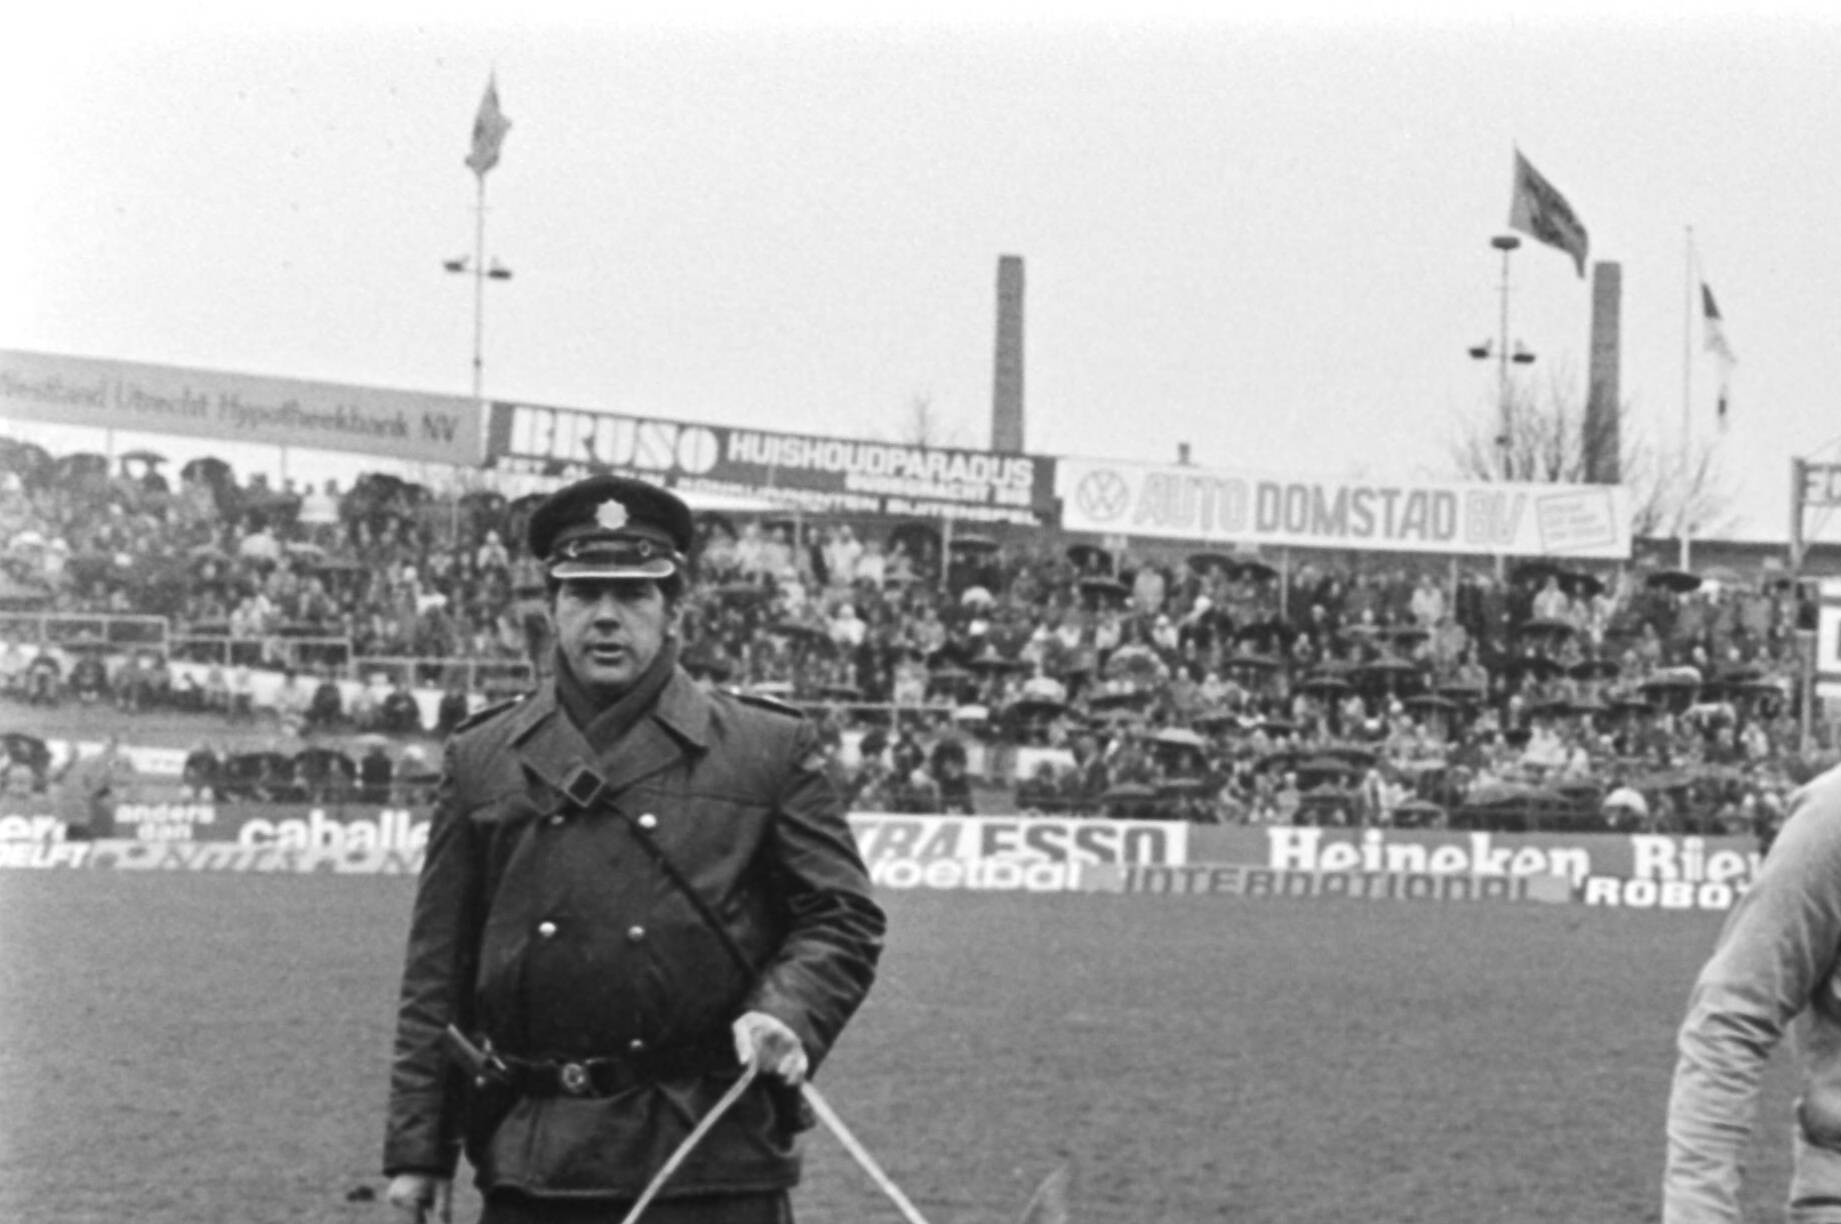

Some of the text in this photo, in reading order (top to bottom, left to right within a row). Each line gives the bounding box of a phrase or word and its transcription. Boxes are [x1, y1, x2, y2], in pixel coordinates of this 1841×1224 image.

[509, 406, 719, 475] BRUNO
[1133, 471, 1249, 532] AUTO
[1256, 481, 1457, 541] DOMSTAD
[980, 822, 1167, 866] ESSO
[1268, 826, 1590, 887] Heineken
[1585, 876, 1748, 910] ROBO
